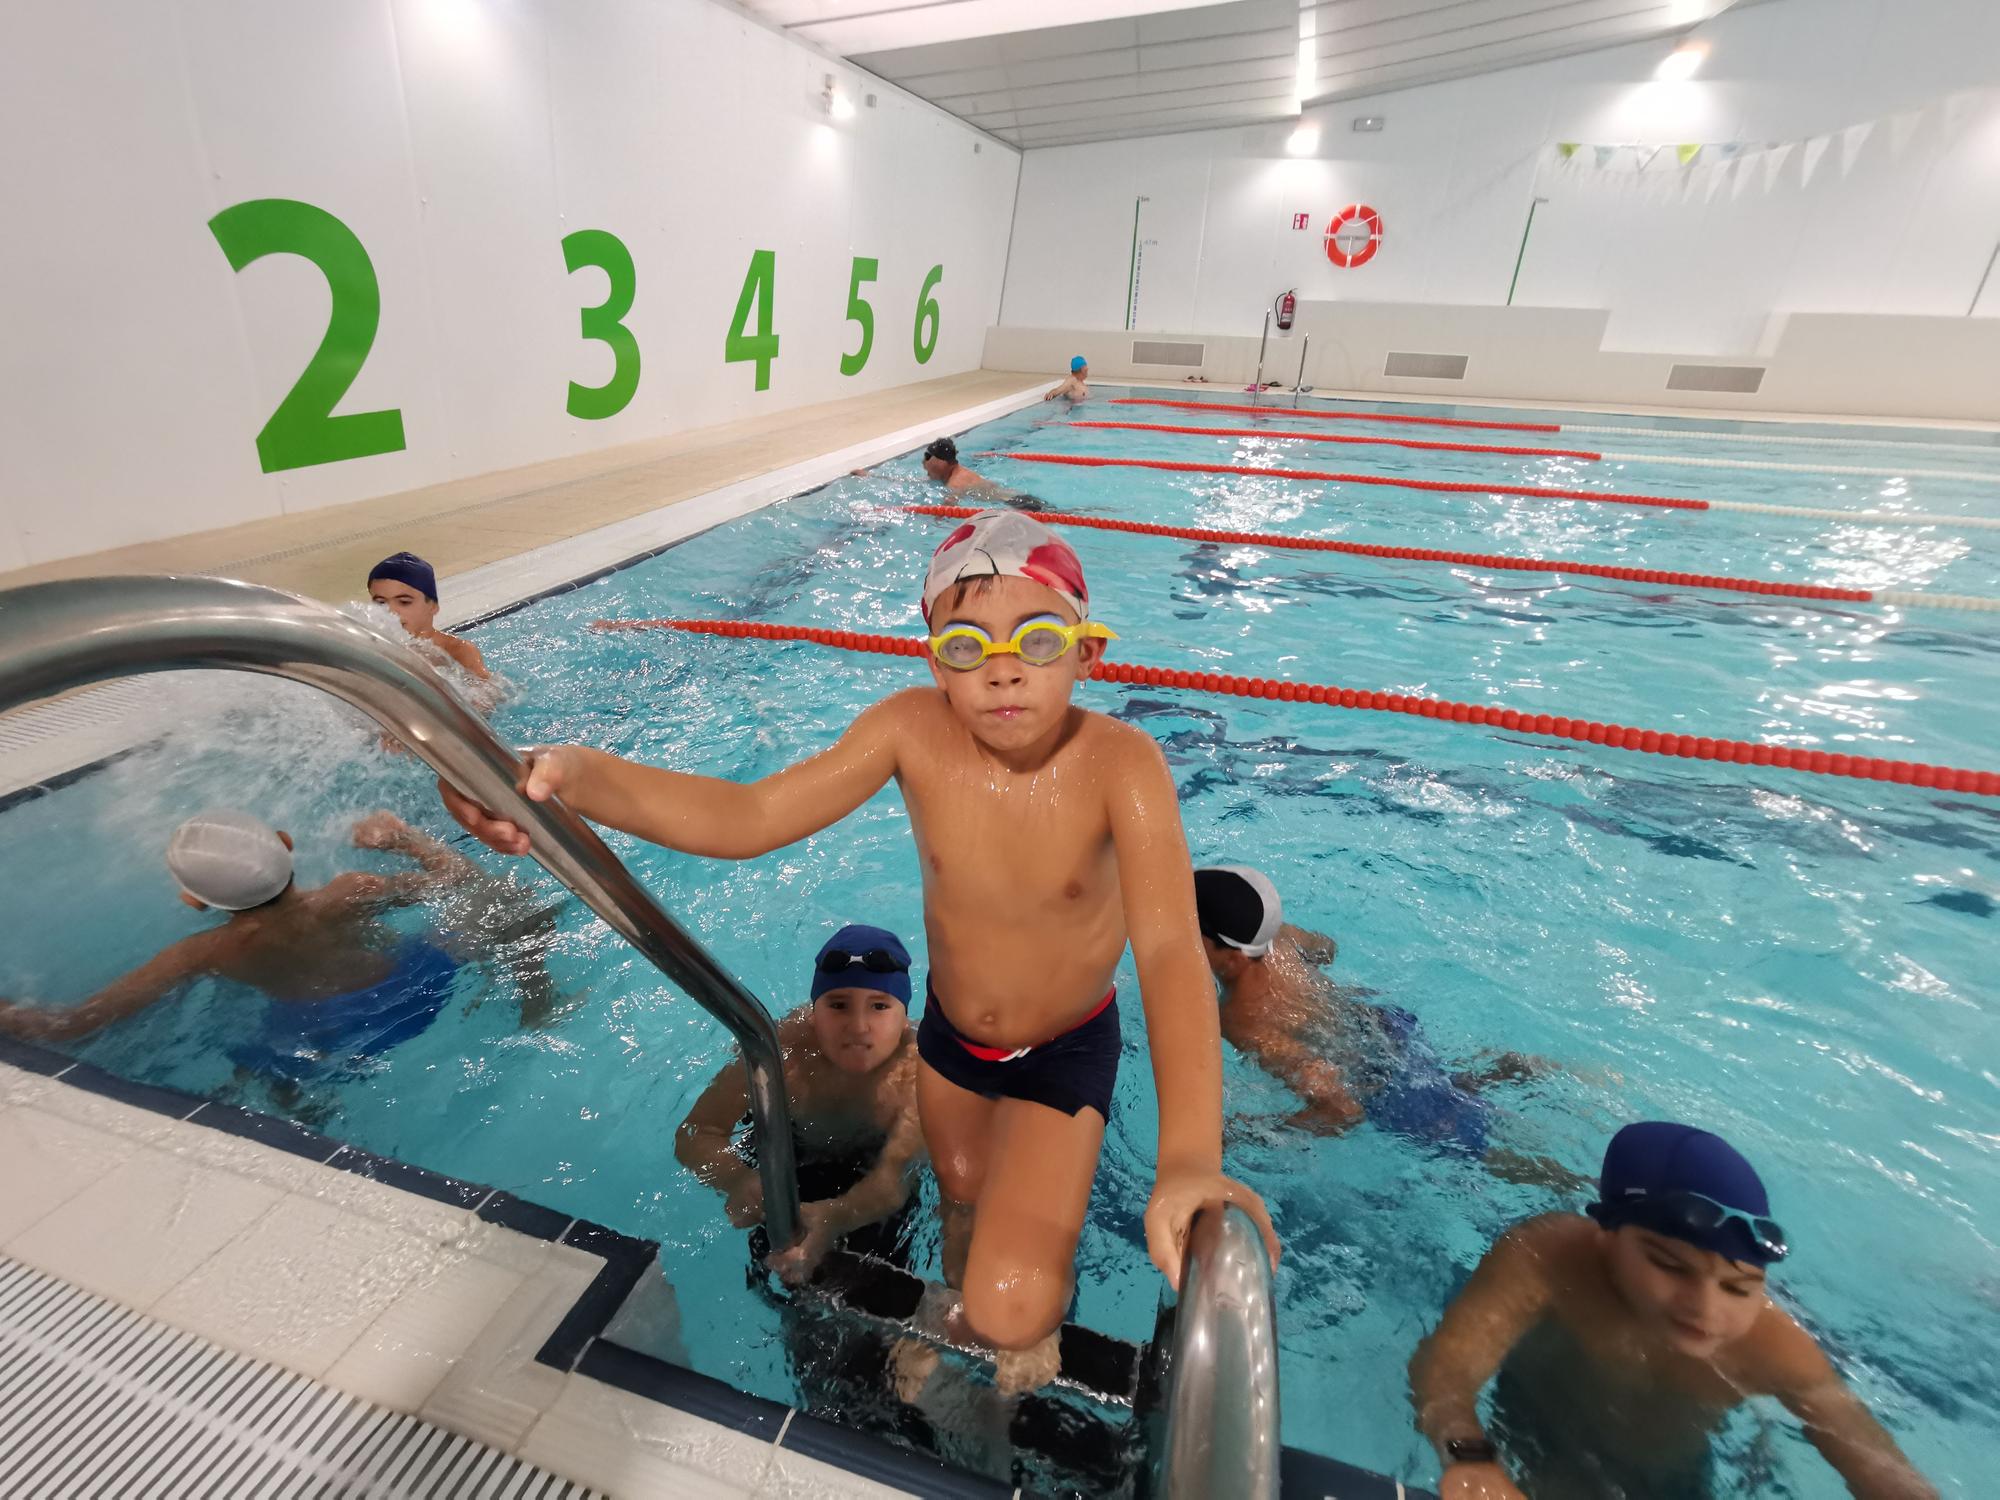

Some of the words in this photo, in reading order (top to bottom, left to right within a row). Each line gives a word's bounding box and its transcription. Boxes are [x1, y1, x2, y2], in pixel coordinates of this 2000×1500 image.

[208, 199, 406, 473] 2
[561, 229, 641, 420] 3
[725, 250, 780, 391] 4
[840, 257, 879, 376] 5
[914, 265, 942, 364] 6
